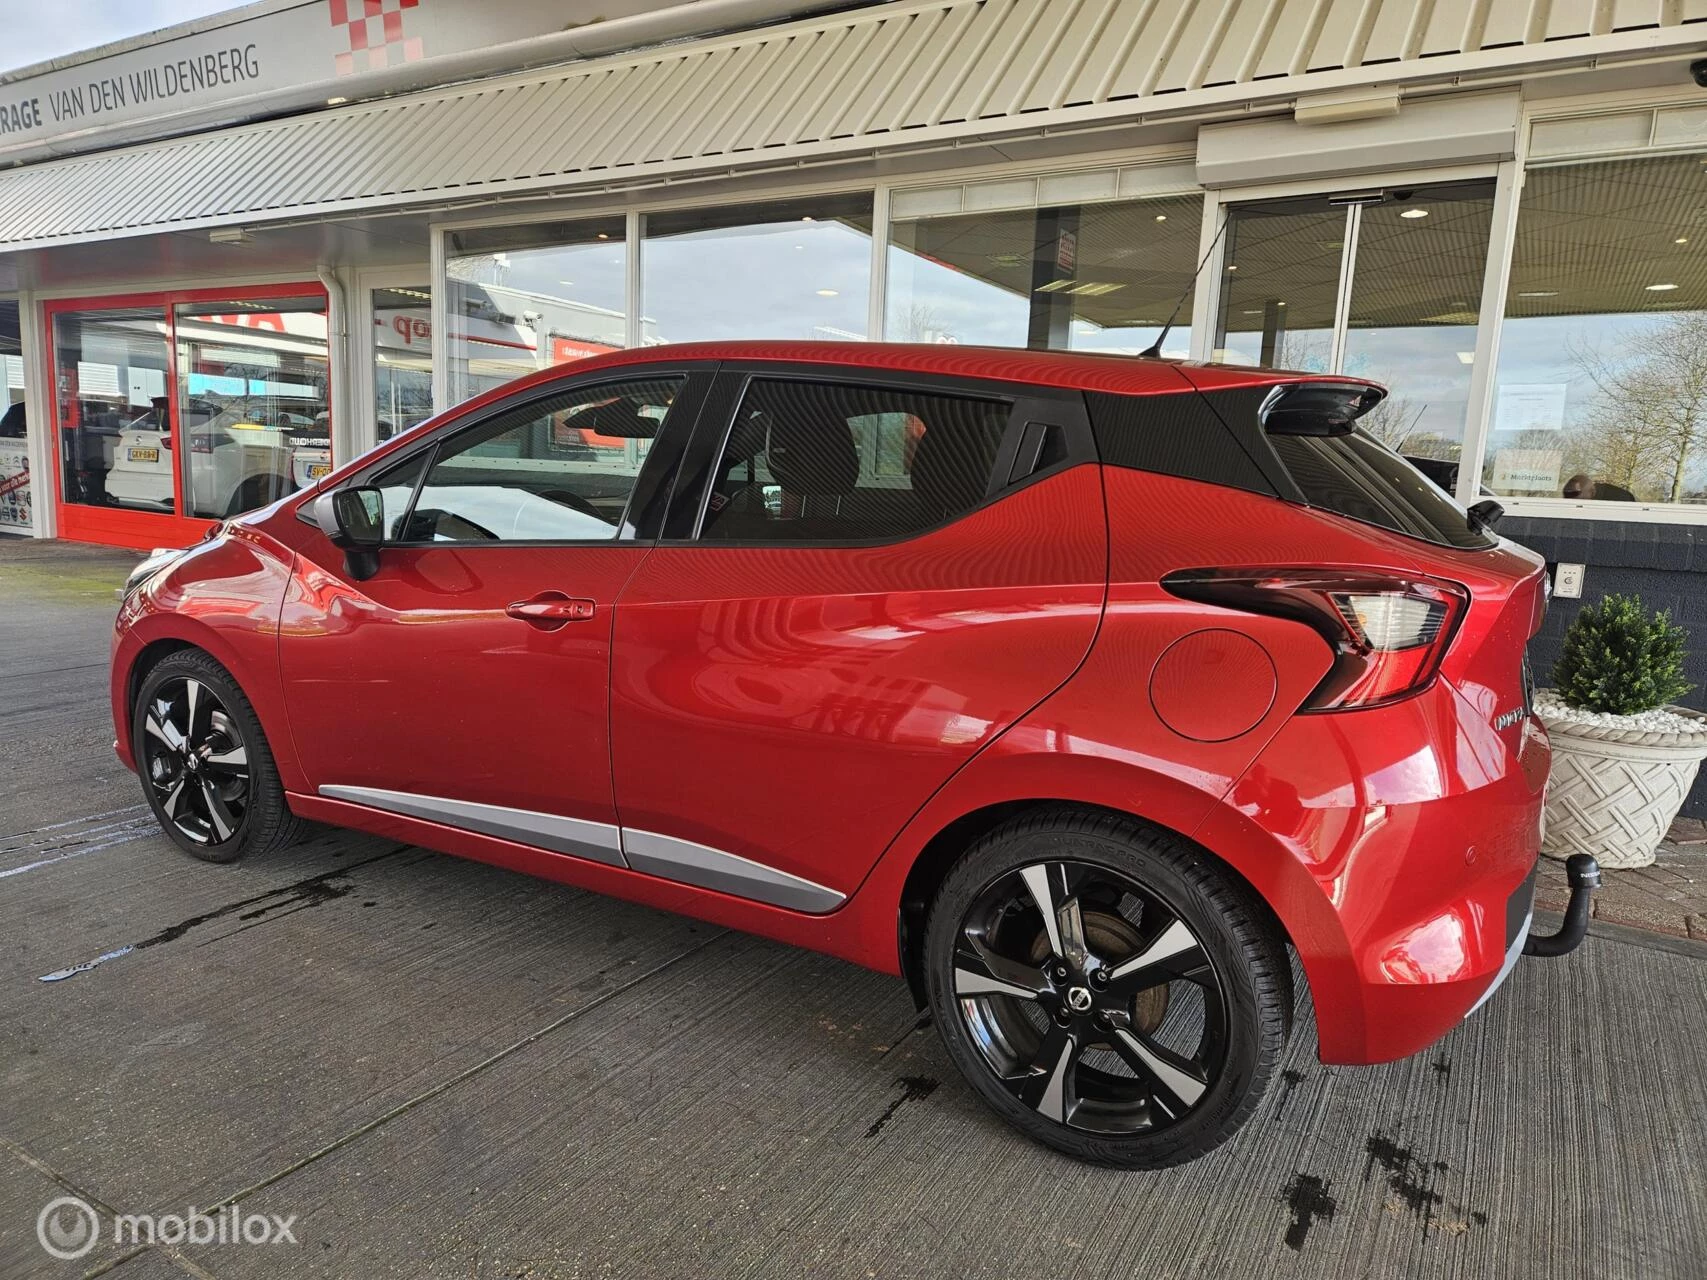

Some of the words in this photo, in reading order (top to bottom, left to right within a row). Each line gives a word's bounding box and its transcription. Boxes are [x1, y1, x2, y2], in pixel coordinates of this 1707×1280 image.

[0, 98, 42, 135] RAGE
[49, 86, 85, 121] VAN
[89, 76, 126, 113] DEN
[129, 44, 259, 104] WILDENBERG
